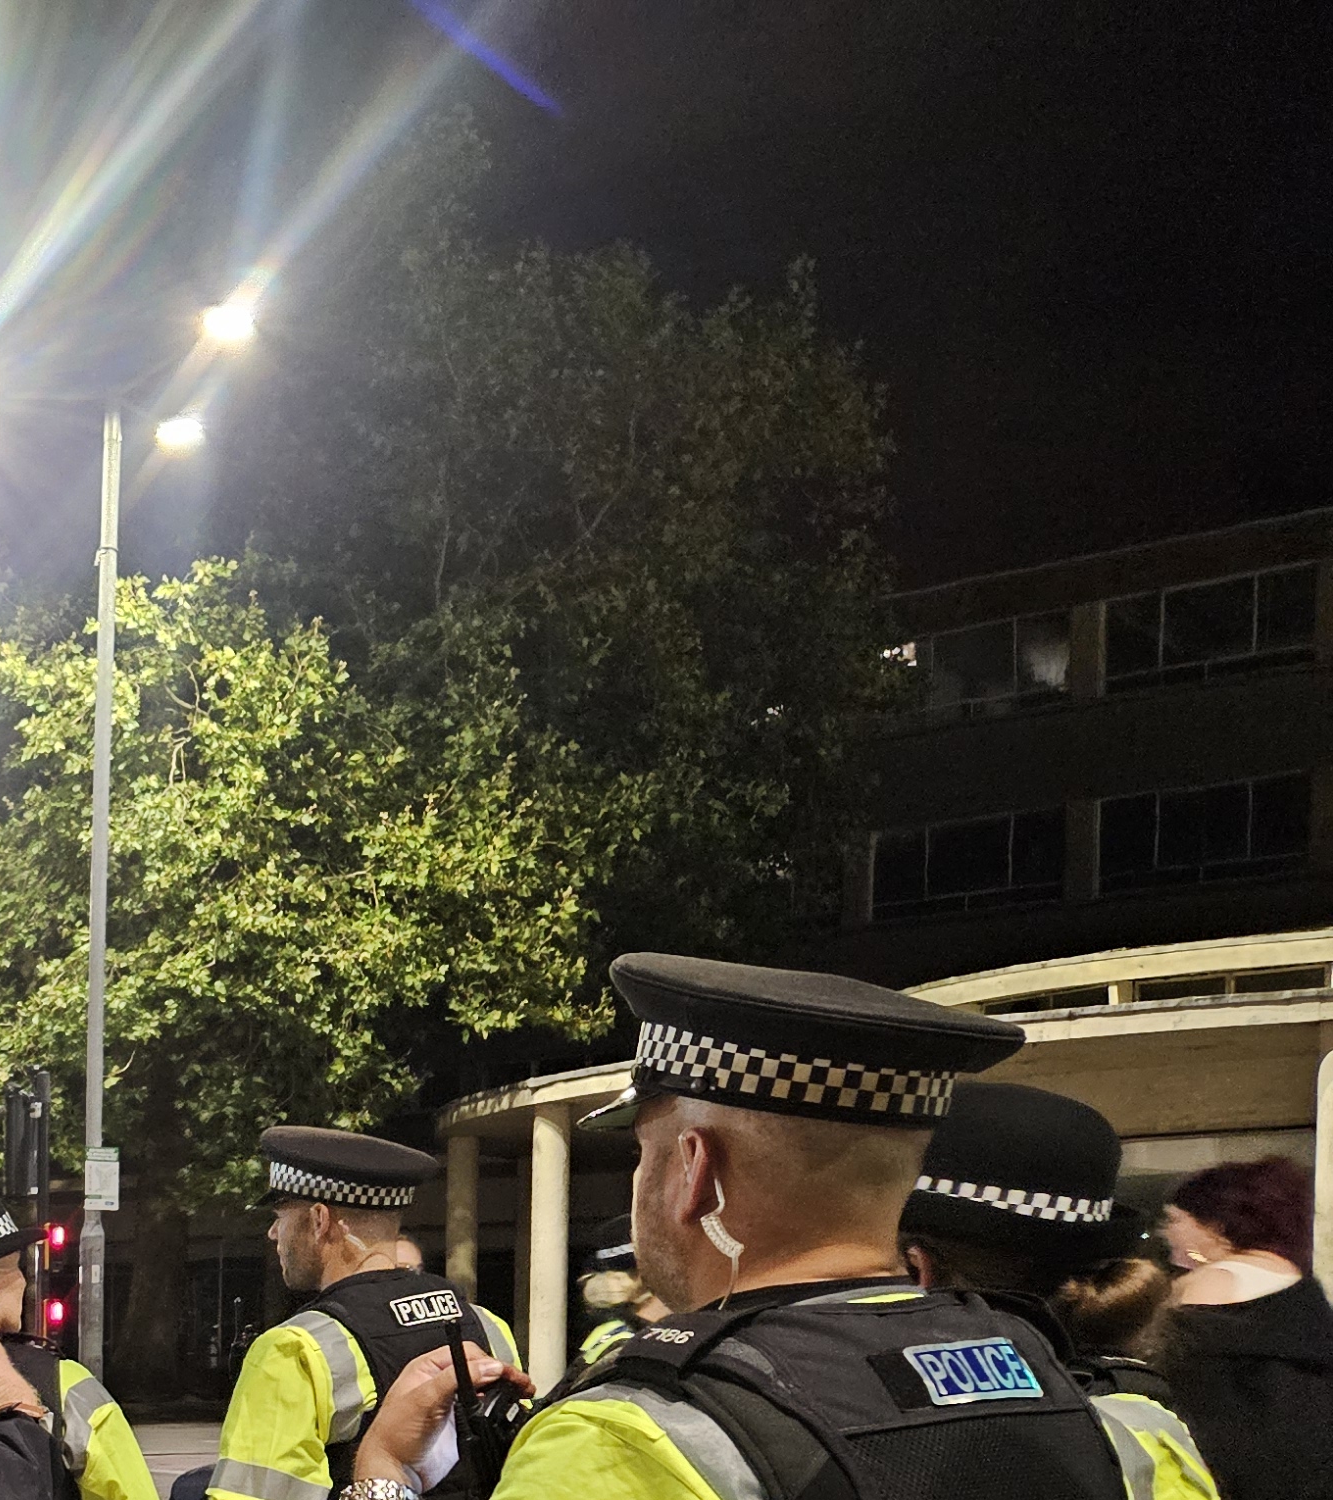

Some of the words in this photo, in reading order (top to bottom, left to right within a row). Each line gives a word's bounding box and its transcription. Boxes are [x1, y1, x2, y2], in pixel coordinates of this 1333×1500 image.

[396, 1294, 458, 1322] POLICE
[641, 1327, 695, 1344] 7186
[918, 1345, 1032, 1395] POLICE
